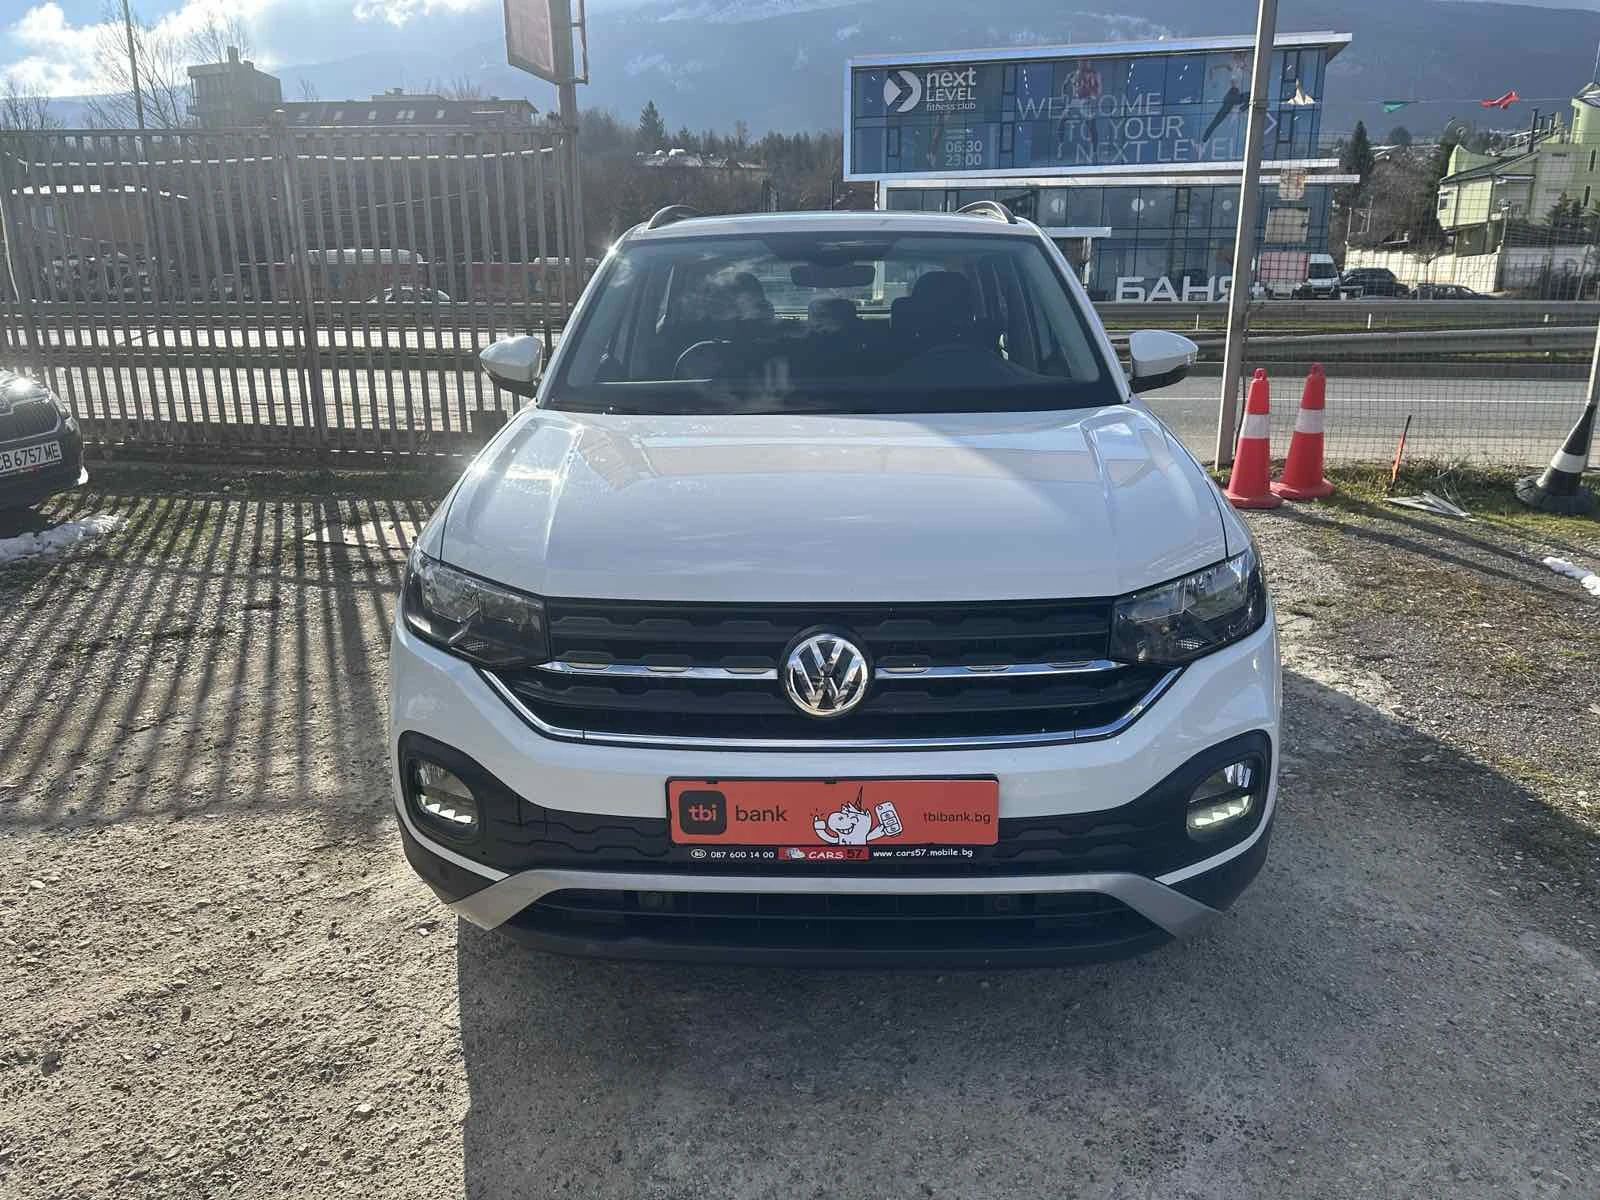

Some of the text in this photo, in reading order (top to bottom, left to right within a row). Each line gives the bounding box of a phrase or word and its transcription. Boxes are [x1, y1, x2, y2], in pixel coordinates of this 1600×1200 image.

[925, 67, 977, 87] next
[925, 87, 977, 102] LEVEL
[926, 101, 977, 112] fitness club
[1016, 92, 1162, 121] WELCOME
[1109, 115, 1185, 140] YOUR
[945, 140, 984, 154] 06:30
[1074, 136, 1243, 164] NEXT LEVEL
[944, 153, 983, 167] 23:00
[14, 446, 41, 467] 6757
[785, 634, 868, 715] VW
[687, 804, 991, 825] tbi bank tbibank.bg
[710, 851, 775, 859] 087 600 14 00
[872, 848, 974, 858] www.cars57.mobile.bg
